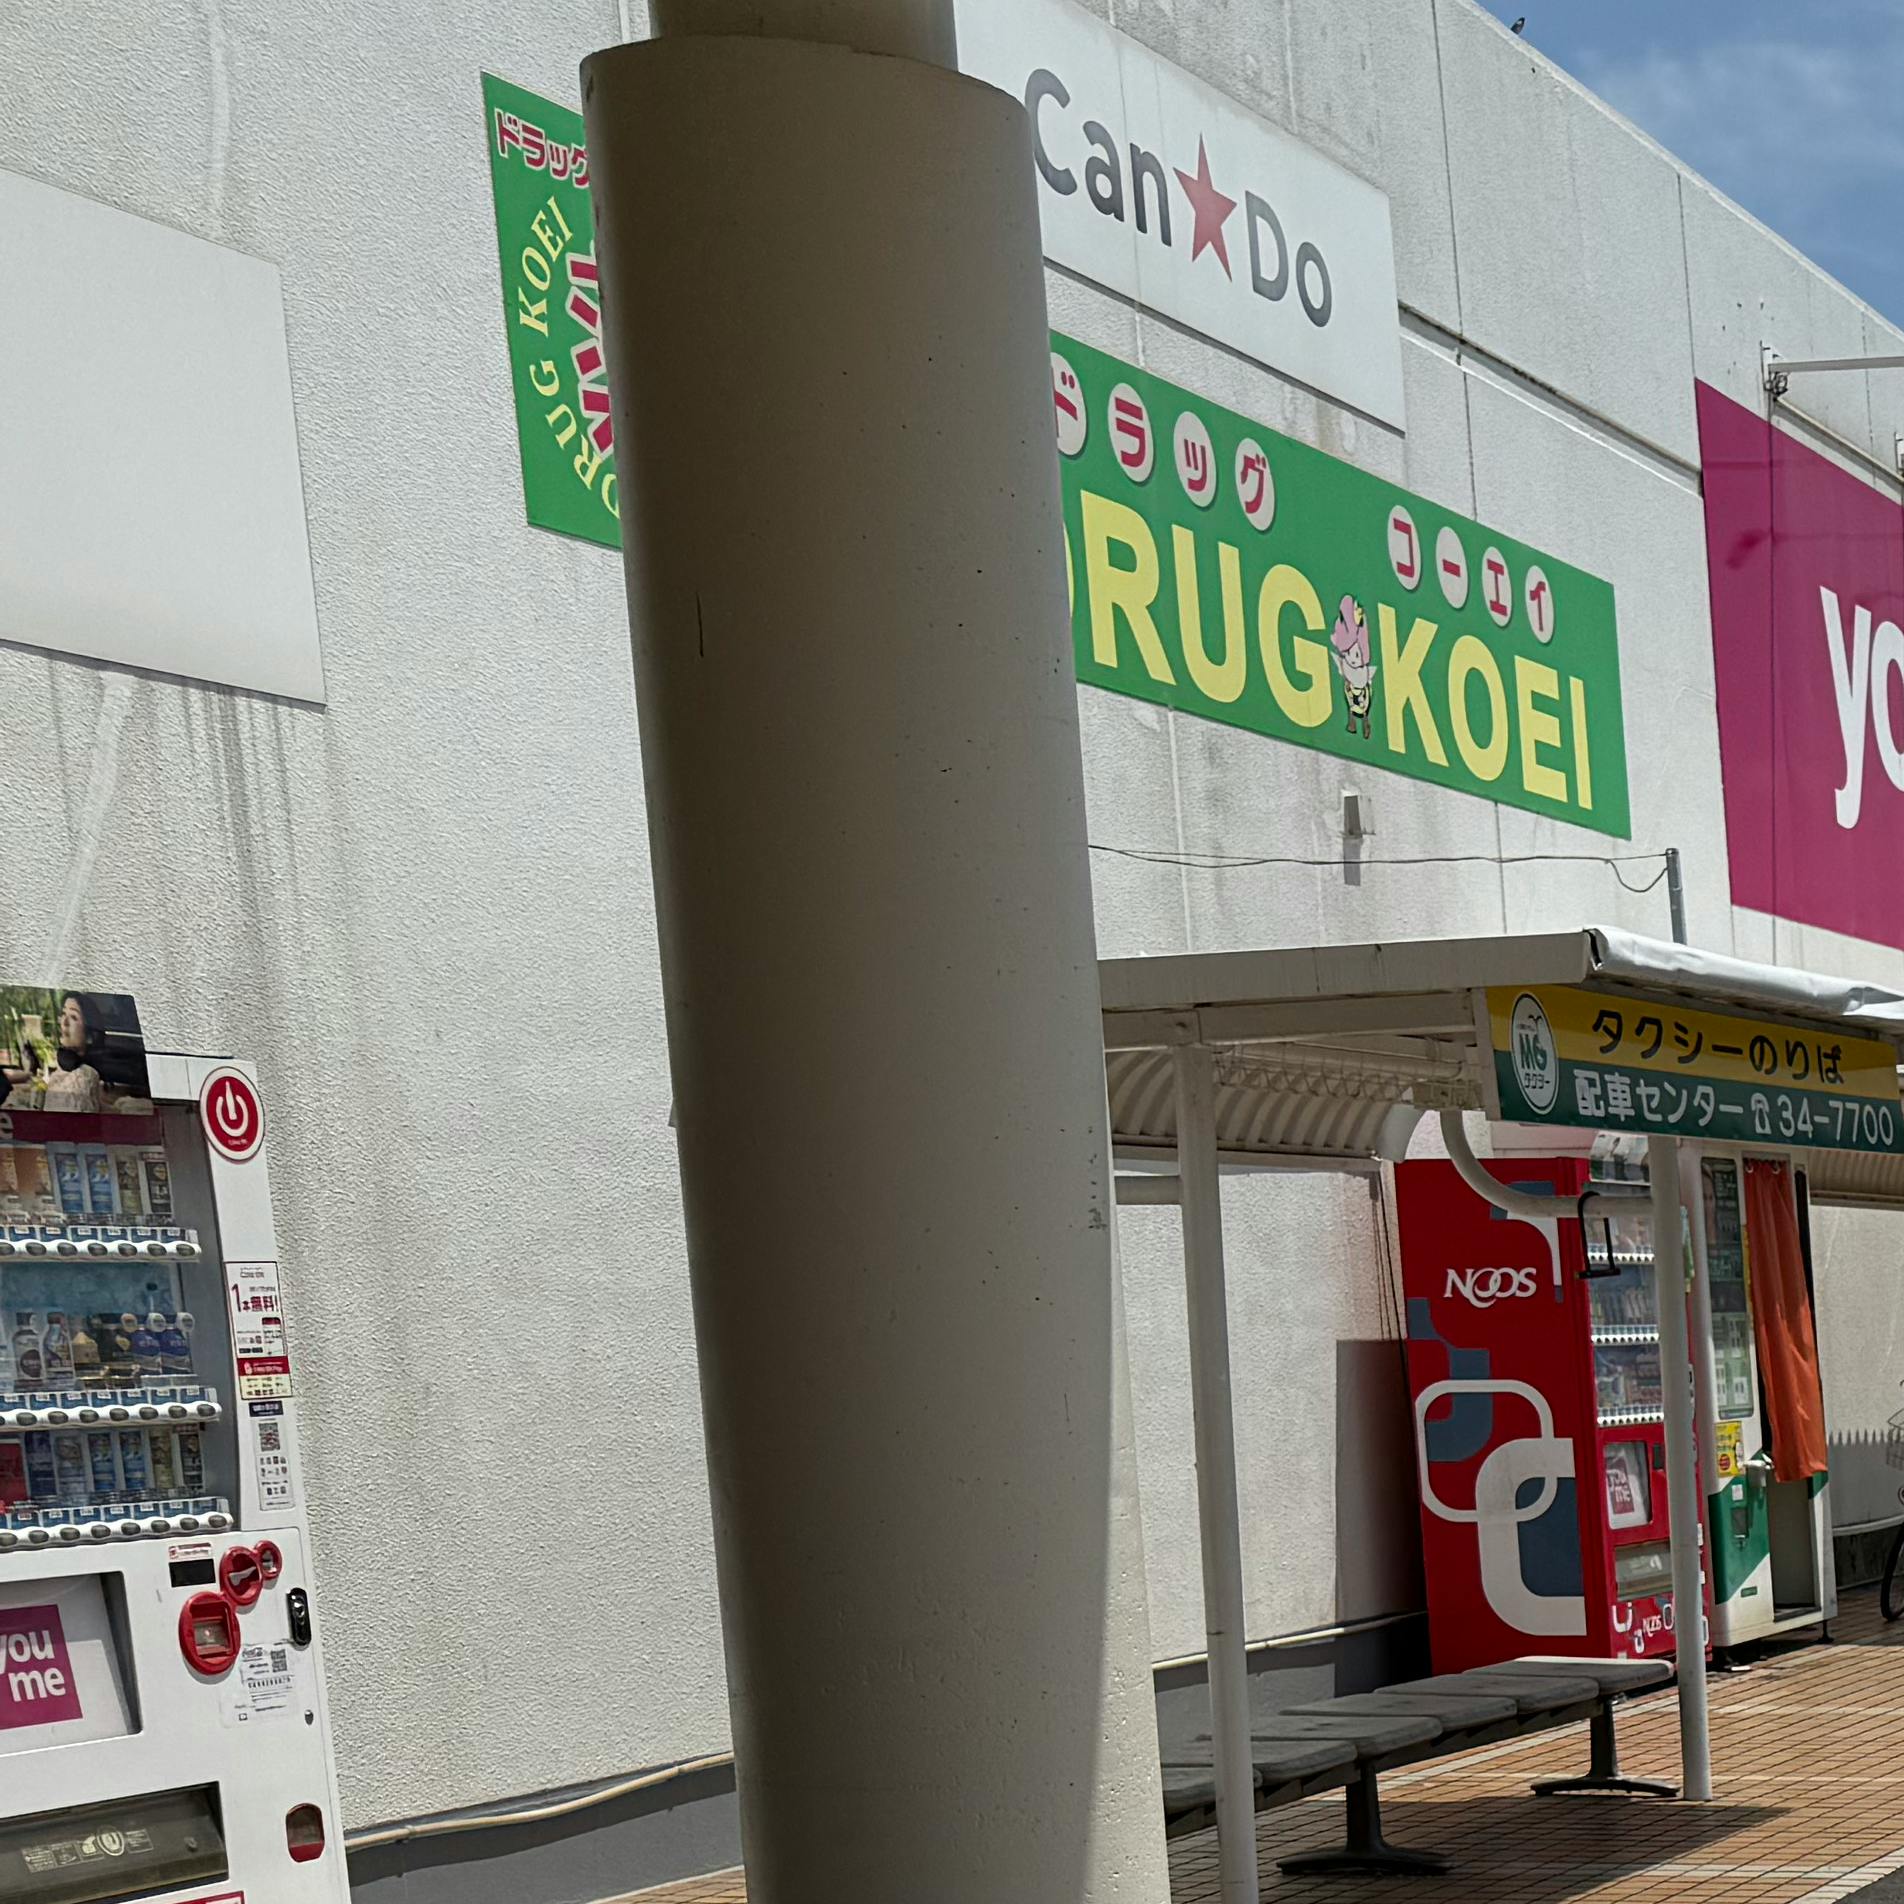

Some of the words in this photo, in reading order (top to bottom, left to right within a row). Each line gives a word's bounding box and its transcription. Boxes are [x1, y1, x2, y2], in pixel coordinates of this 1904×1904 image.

[518, 196, 574, 338] KOEI
[1392, 517, 1547, 632] コーエイ
[1064, 490, 1332, 728] RUG
[1378, 602, 1594, 811] KOEI
[1592, 1009, 1845, 1085] タクシーのりば
[1573, 1069, 1744, 1127] 配車センター
[1778, 1094, 1895, 1147] 34-7700
[8, 1667, 66, 1702] me
